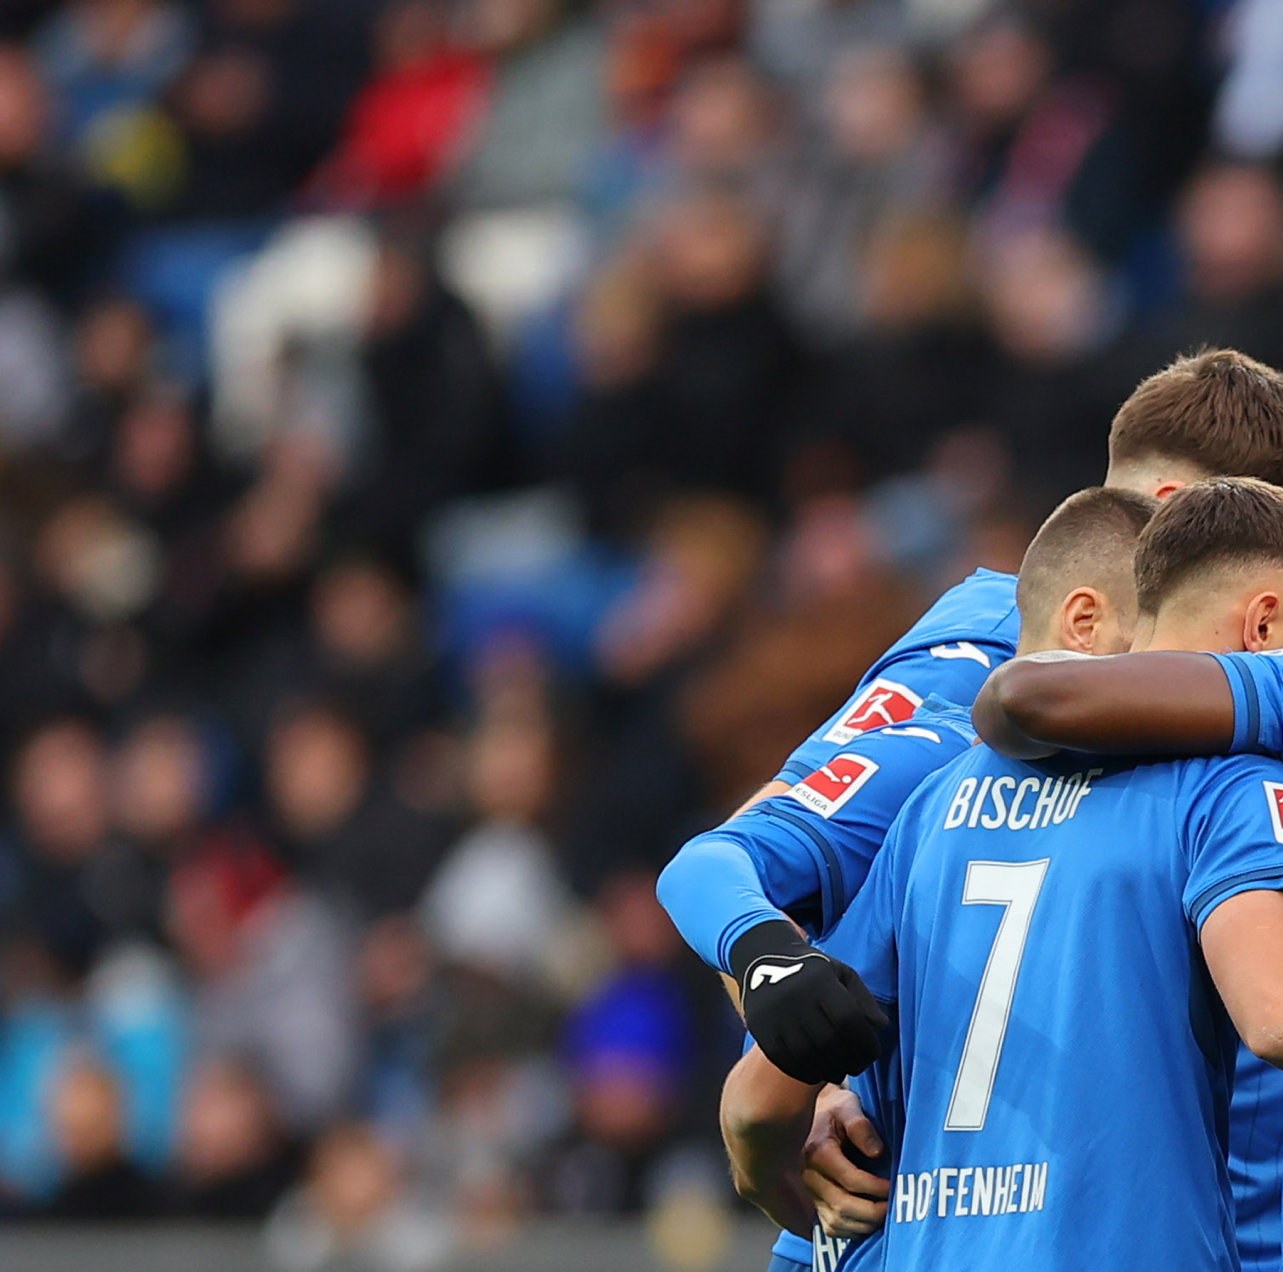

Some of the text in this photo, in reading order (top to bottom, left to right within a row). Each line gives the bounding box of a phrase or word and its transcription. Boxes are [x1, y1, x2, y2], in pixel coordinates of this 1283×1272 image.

[794, 786, 828, 811] ESLIGA
[943, 767, 1104, 831] BISCHOF
[943, 857, 1051, 1132] 7
